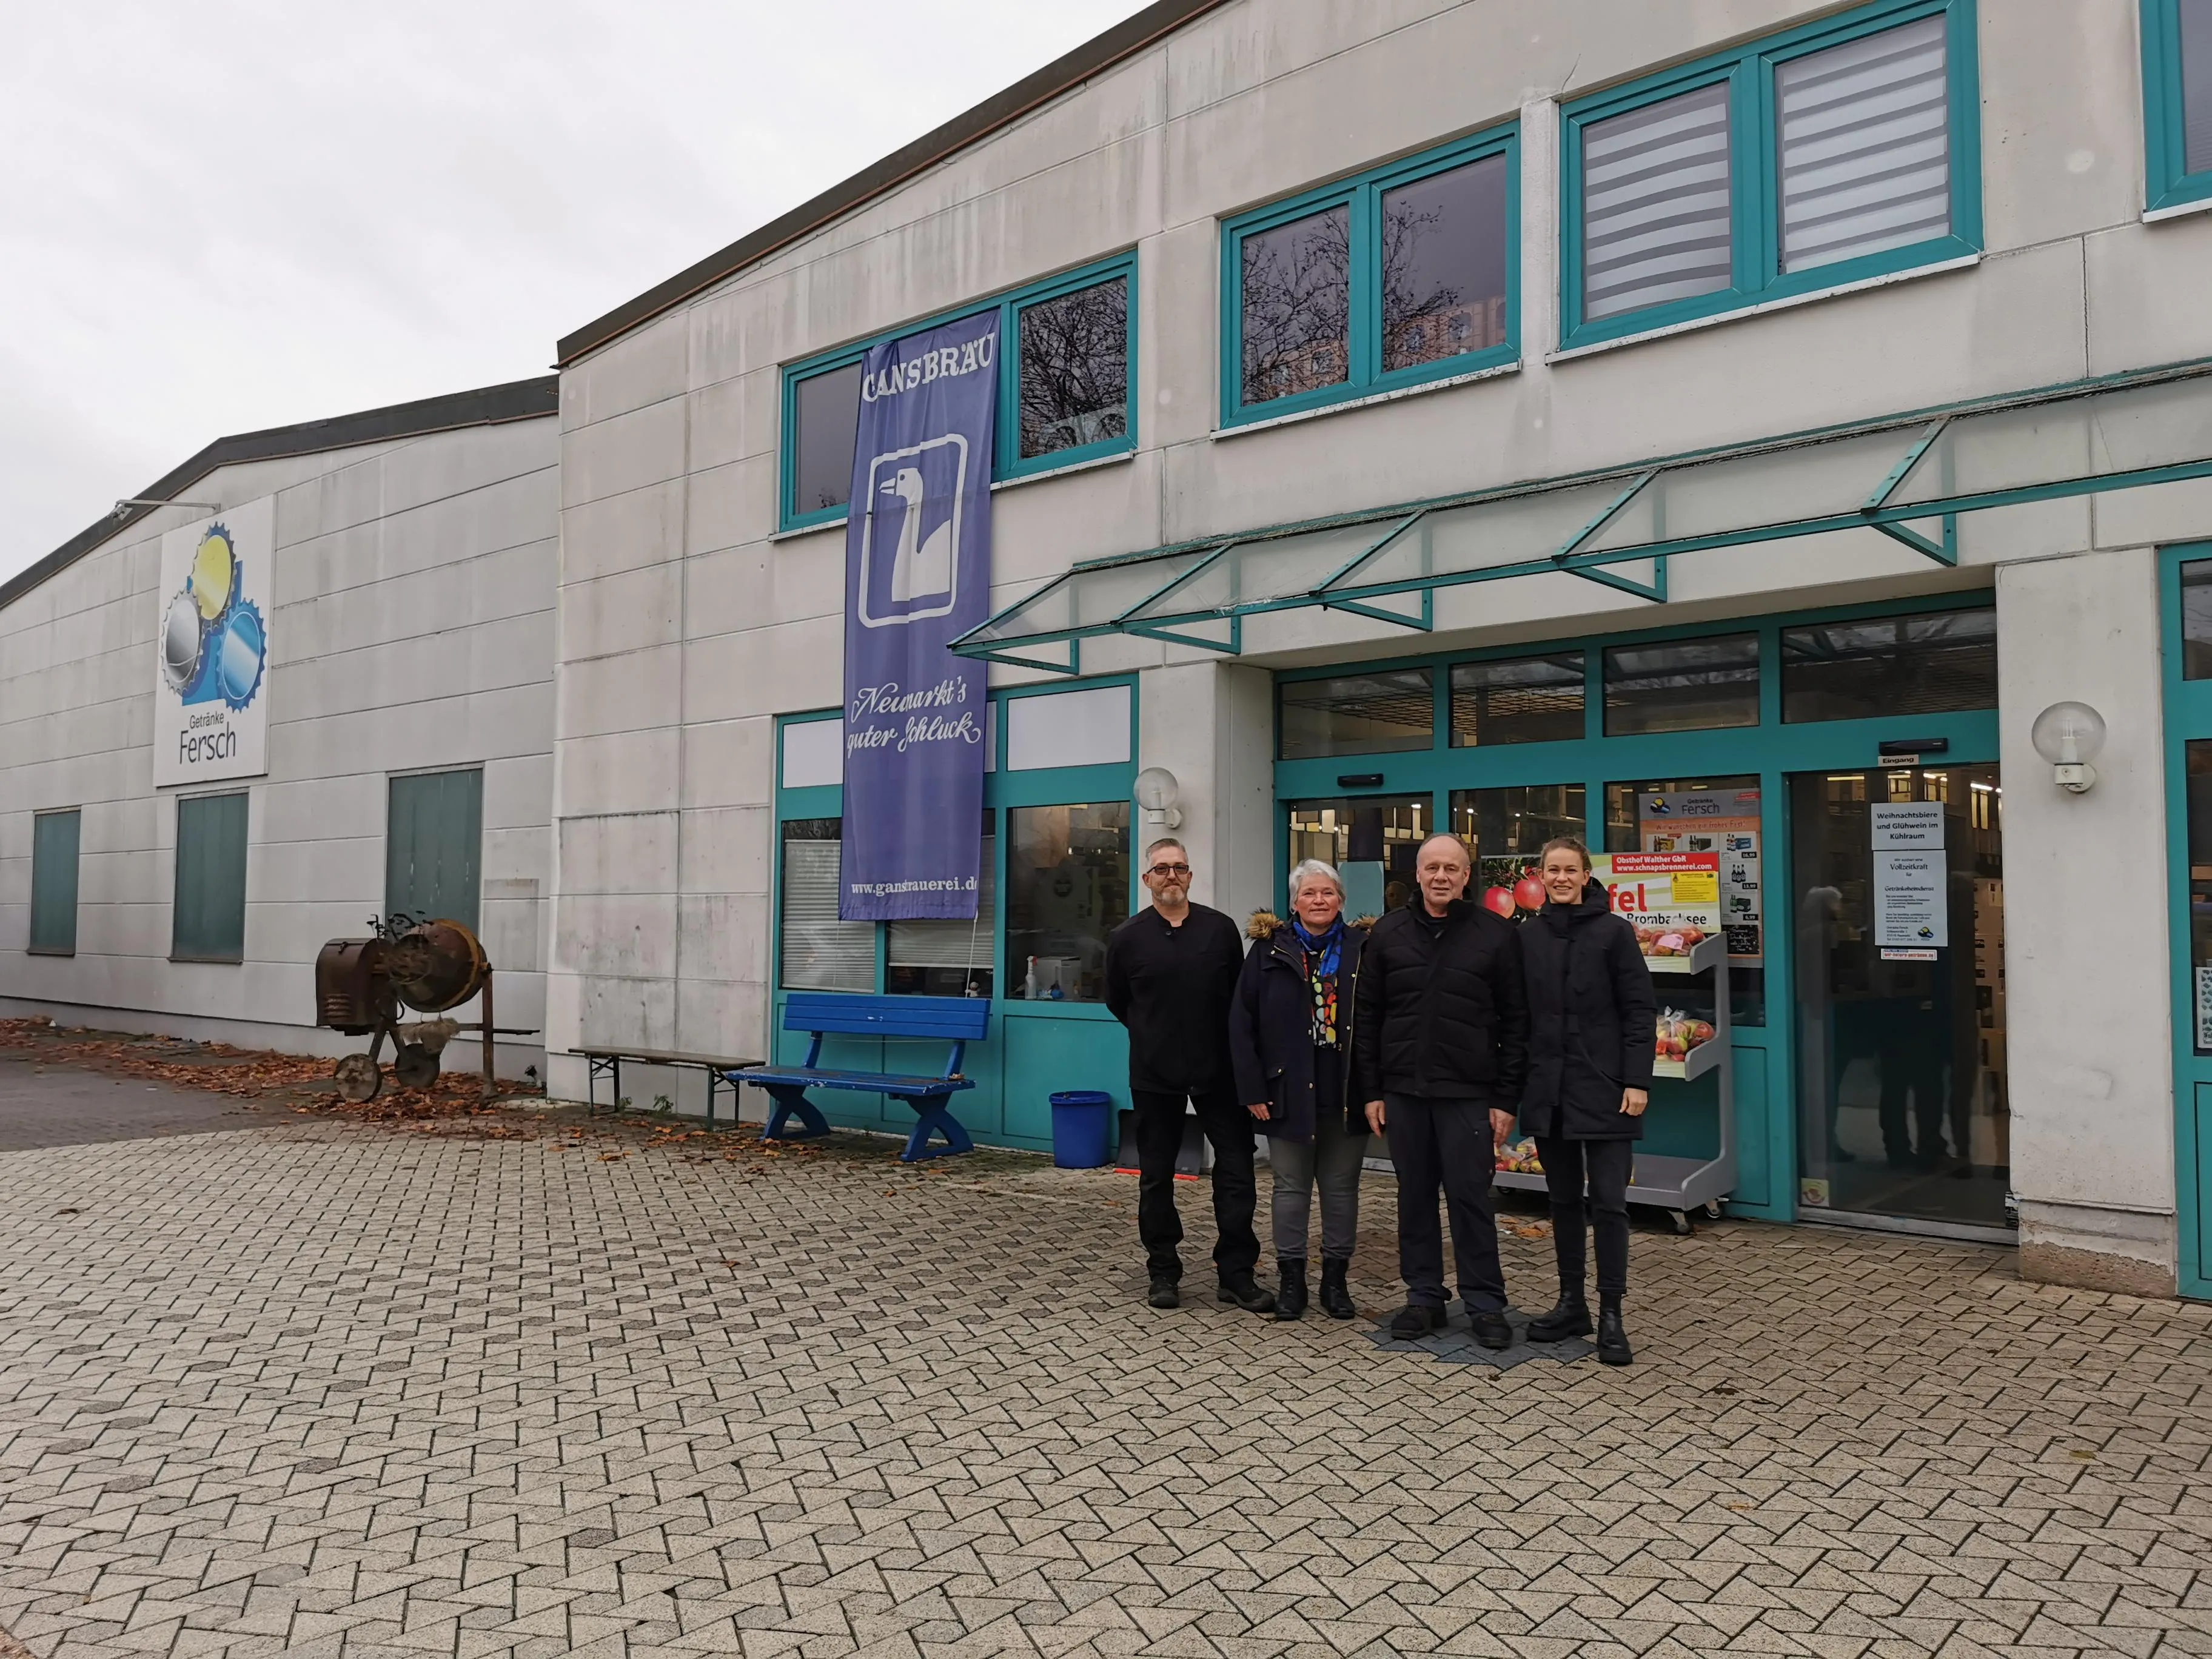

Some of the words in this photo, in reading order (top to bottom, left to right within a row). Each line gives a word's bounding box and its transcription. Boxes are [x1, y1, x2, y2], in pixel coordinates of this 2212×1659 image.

[189, 711, 224, 729] Getränke
[179, 722, 236, 764] Fersch
[847, 725, 898, 759] guter
[897, 712, 981, 752] Schluck
[1682, 803, 1720, 814] Fersch
